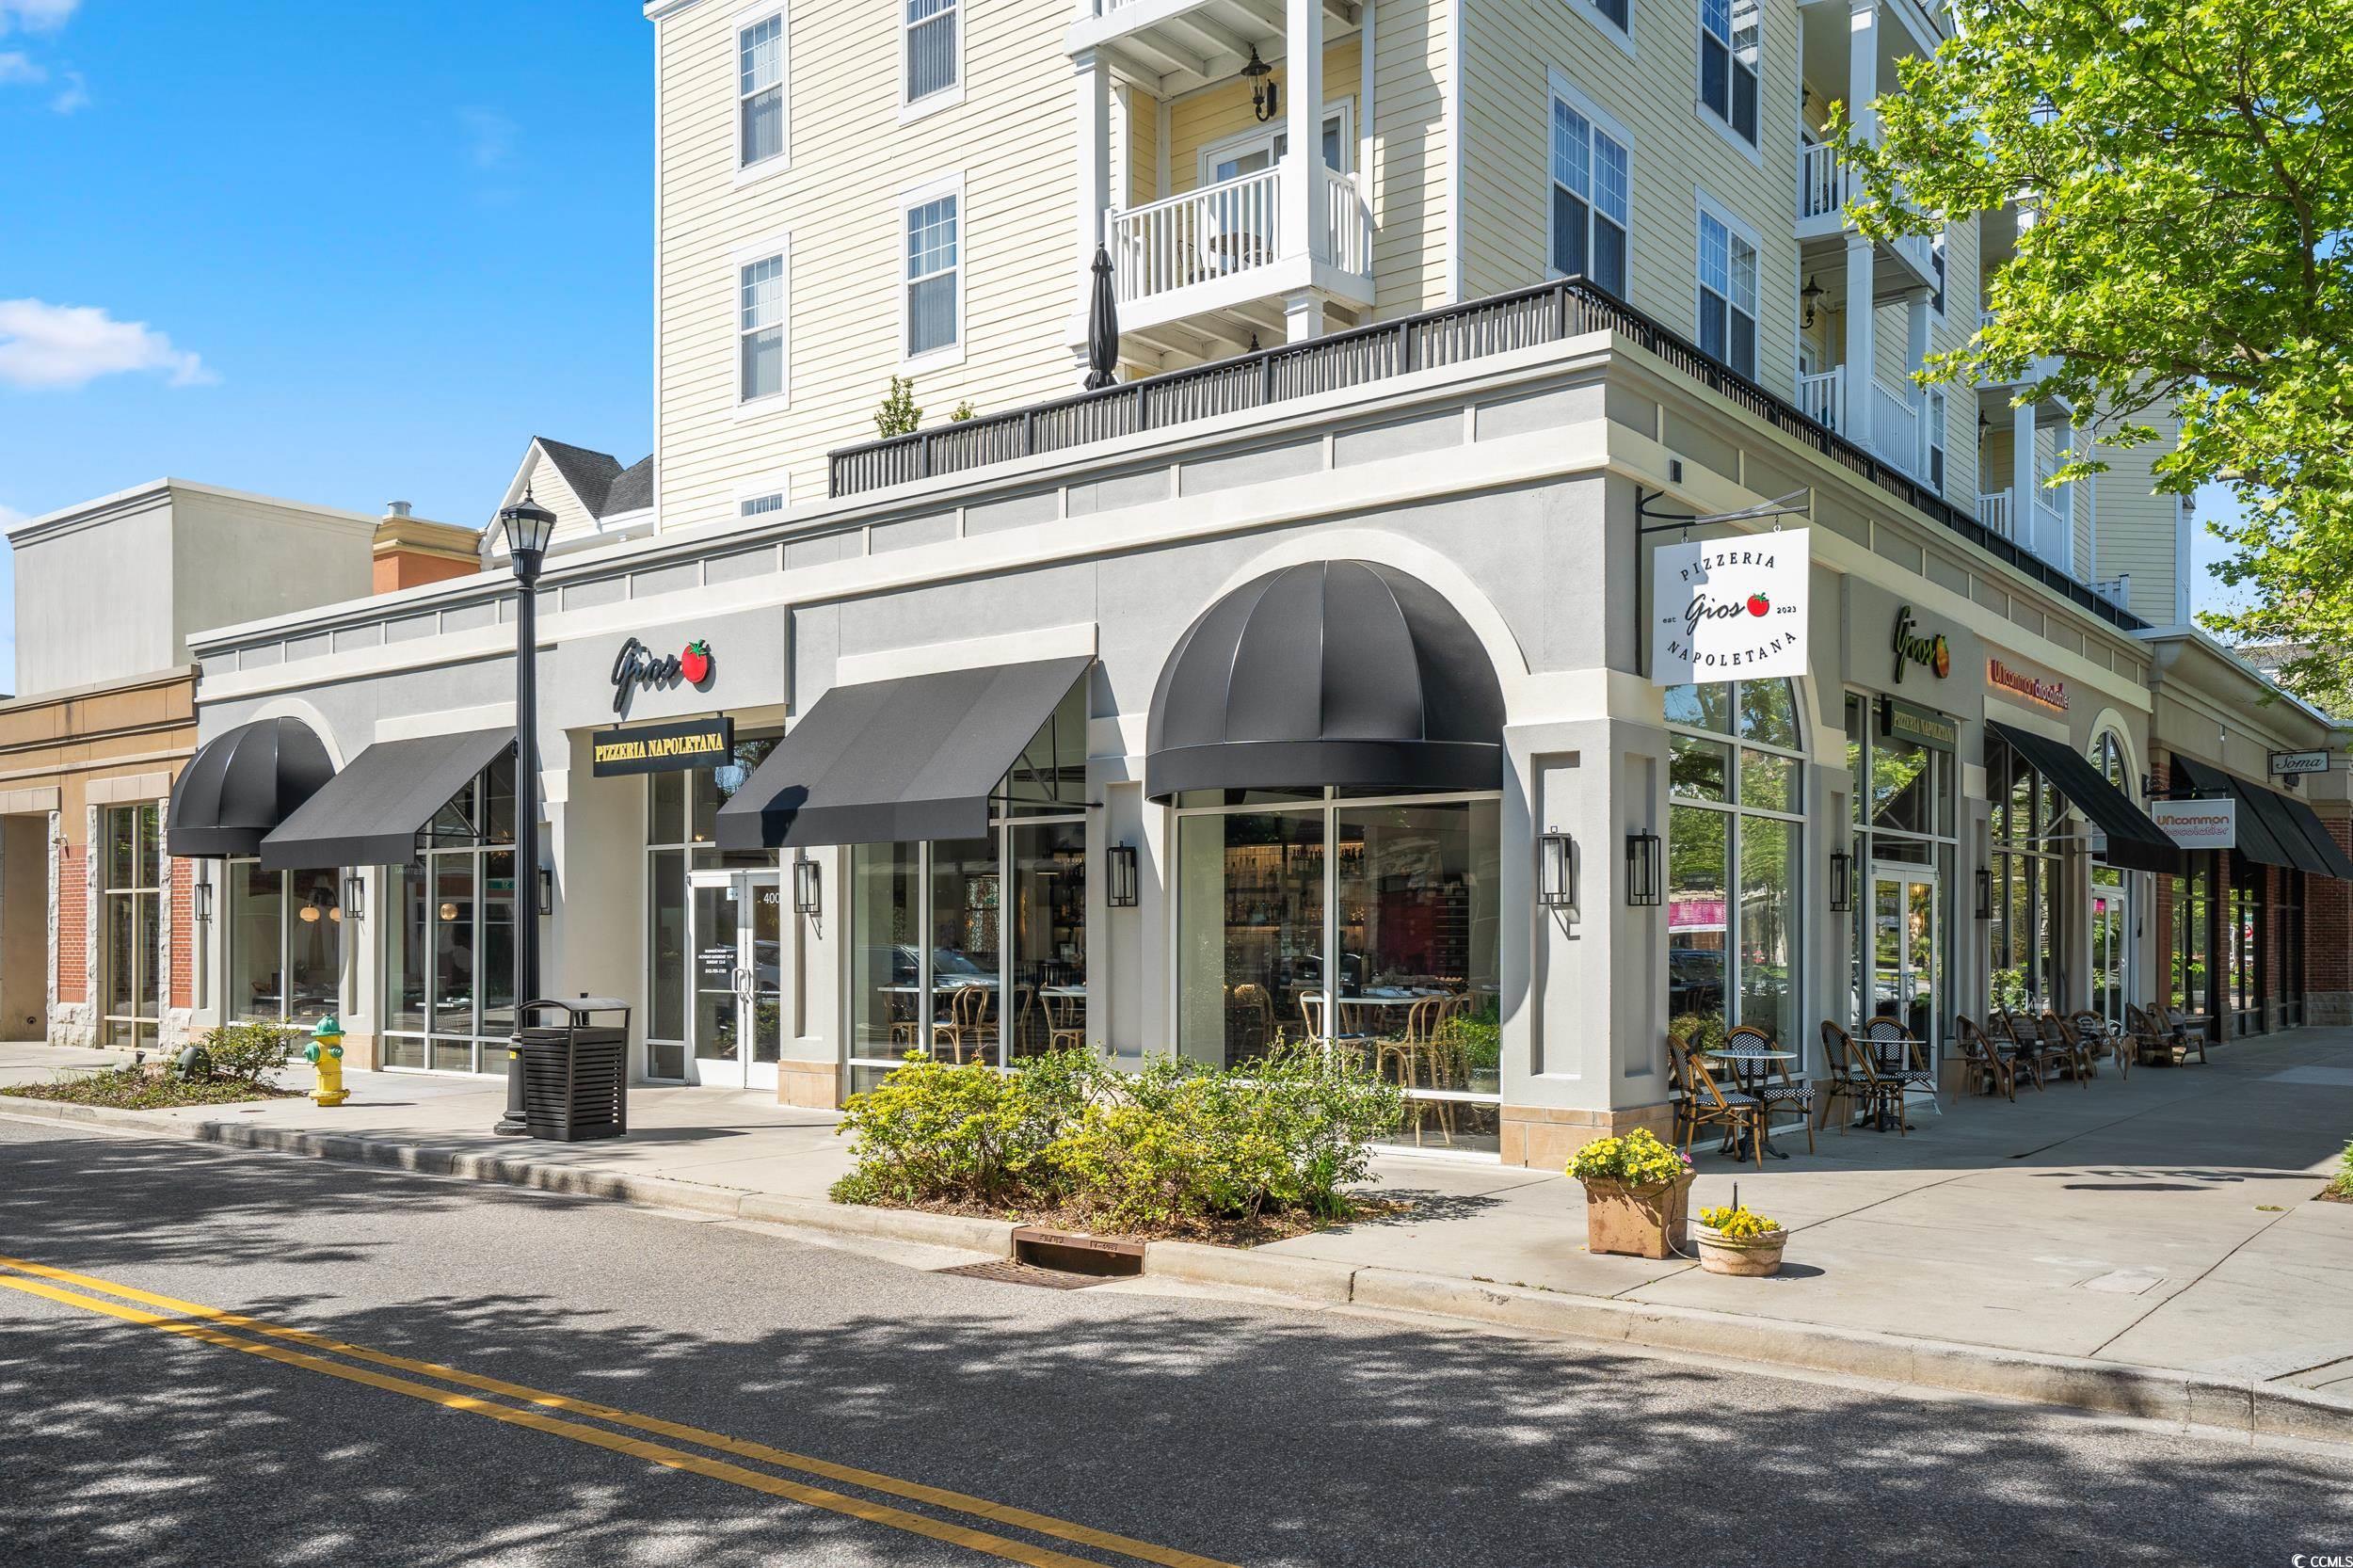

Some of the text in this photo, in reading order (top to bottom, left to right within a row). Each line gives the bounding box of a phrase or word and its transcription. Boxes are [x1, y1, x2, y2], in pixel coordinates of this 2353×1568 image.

[1680, 552, 1776, 582] PIZZERIA
[1685, 593, 1745, 636] Gios
[1776, 606, 1797, 615] 2023
[1667, 632, 1797, 666] NAPOLETANA
[611, 637, 682, 712] Gios
[1893, 710, 1920, 733] PIZZERIA
[595, 732, 725, 762] PIZZERIA NAPOLETANA
[2275, 755, 2324, 769] Soma
[2164, 824, 2229, 837] hocolatier
[763, 892, 780, 904] 400
